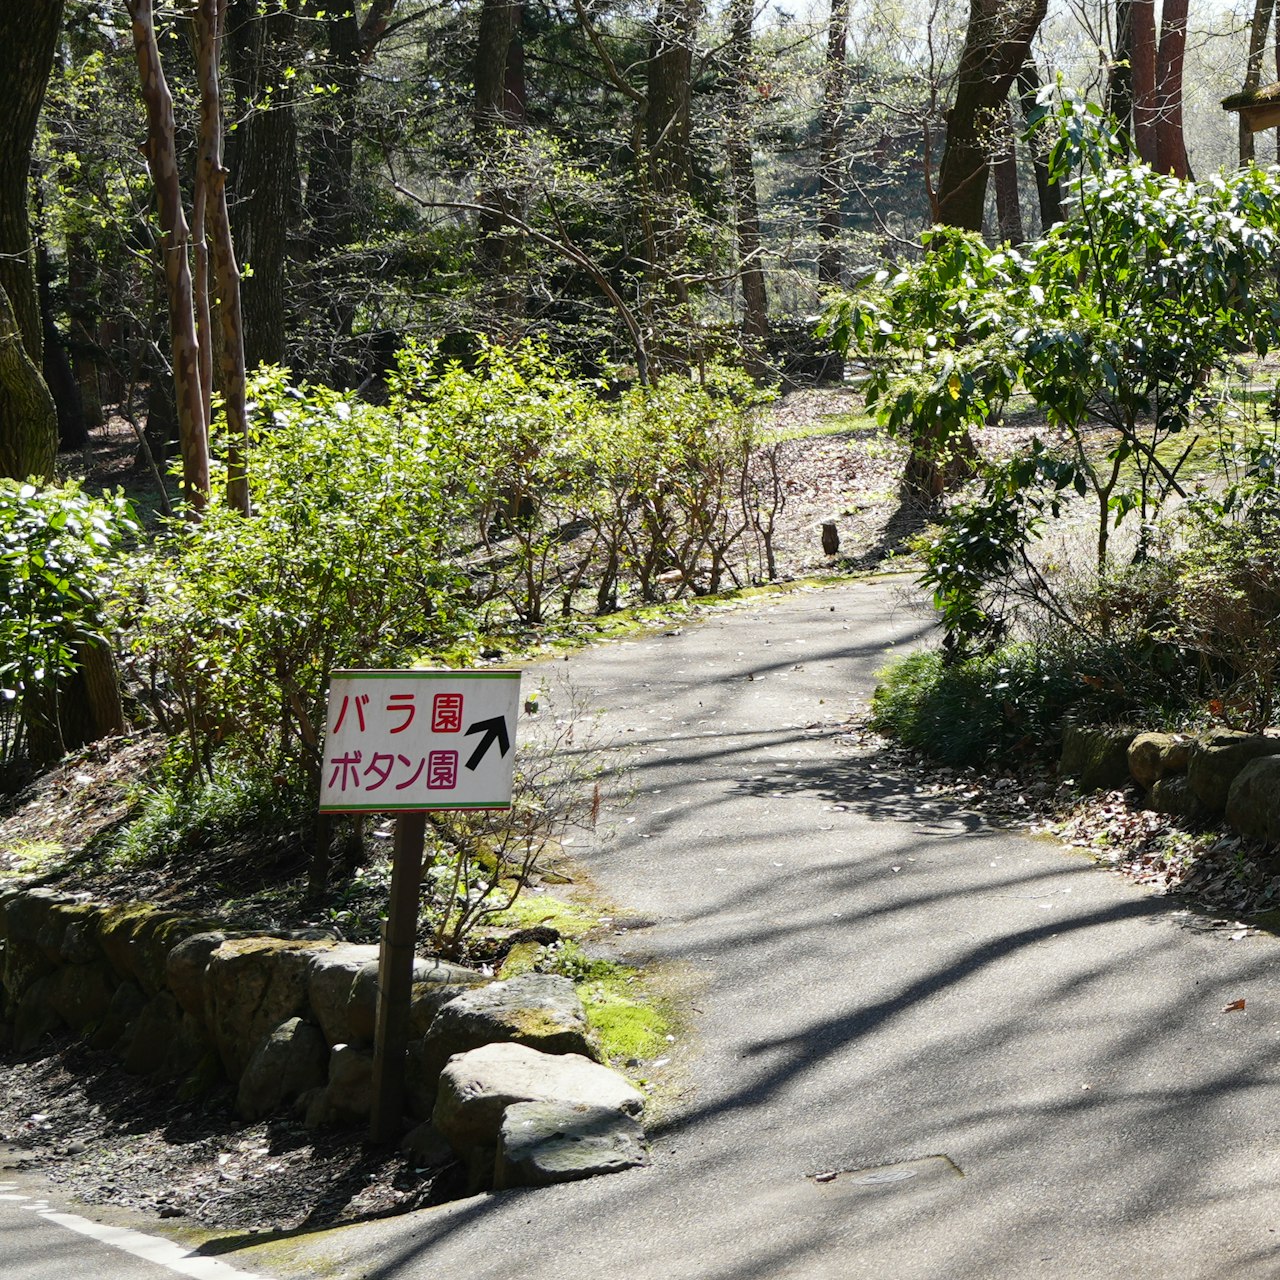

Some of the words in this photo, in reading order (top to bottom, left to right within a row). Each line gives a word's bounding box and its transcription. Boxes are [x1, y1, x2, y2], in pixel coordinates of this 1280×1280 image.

[333, 693, 464, 734] バラ園
[328, 750, 459, 791] ボタン園
